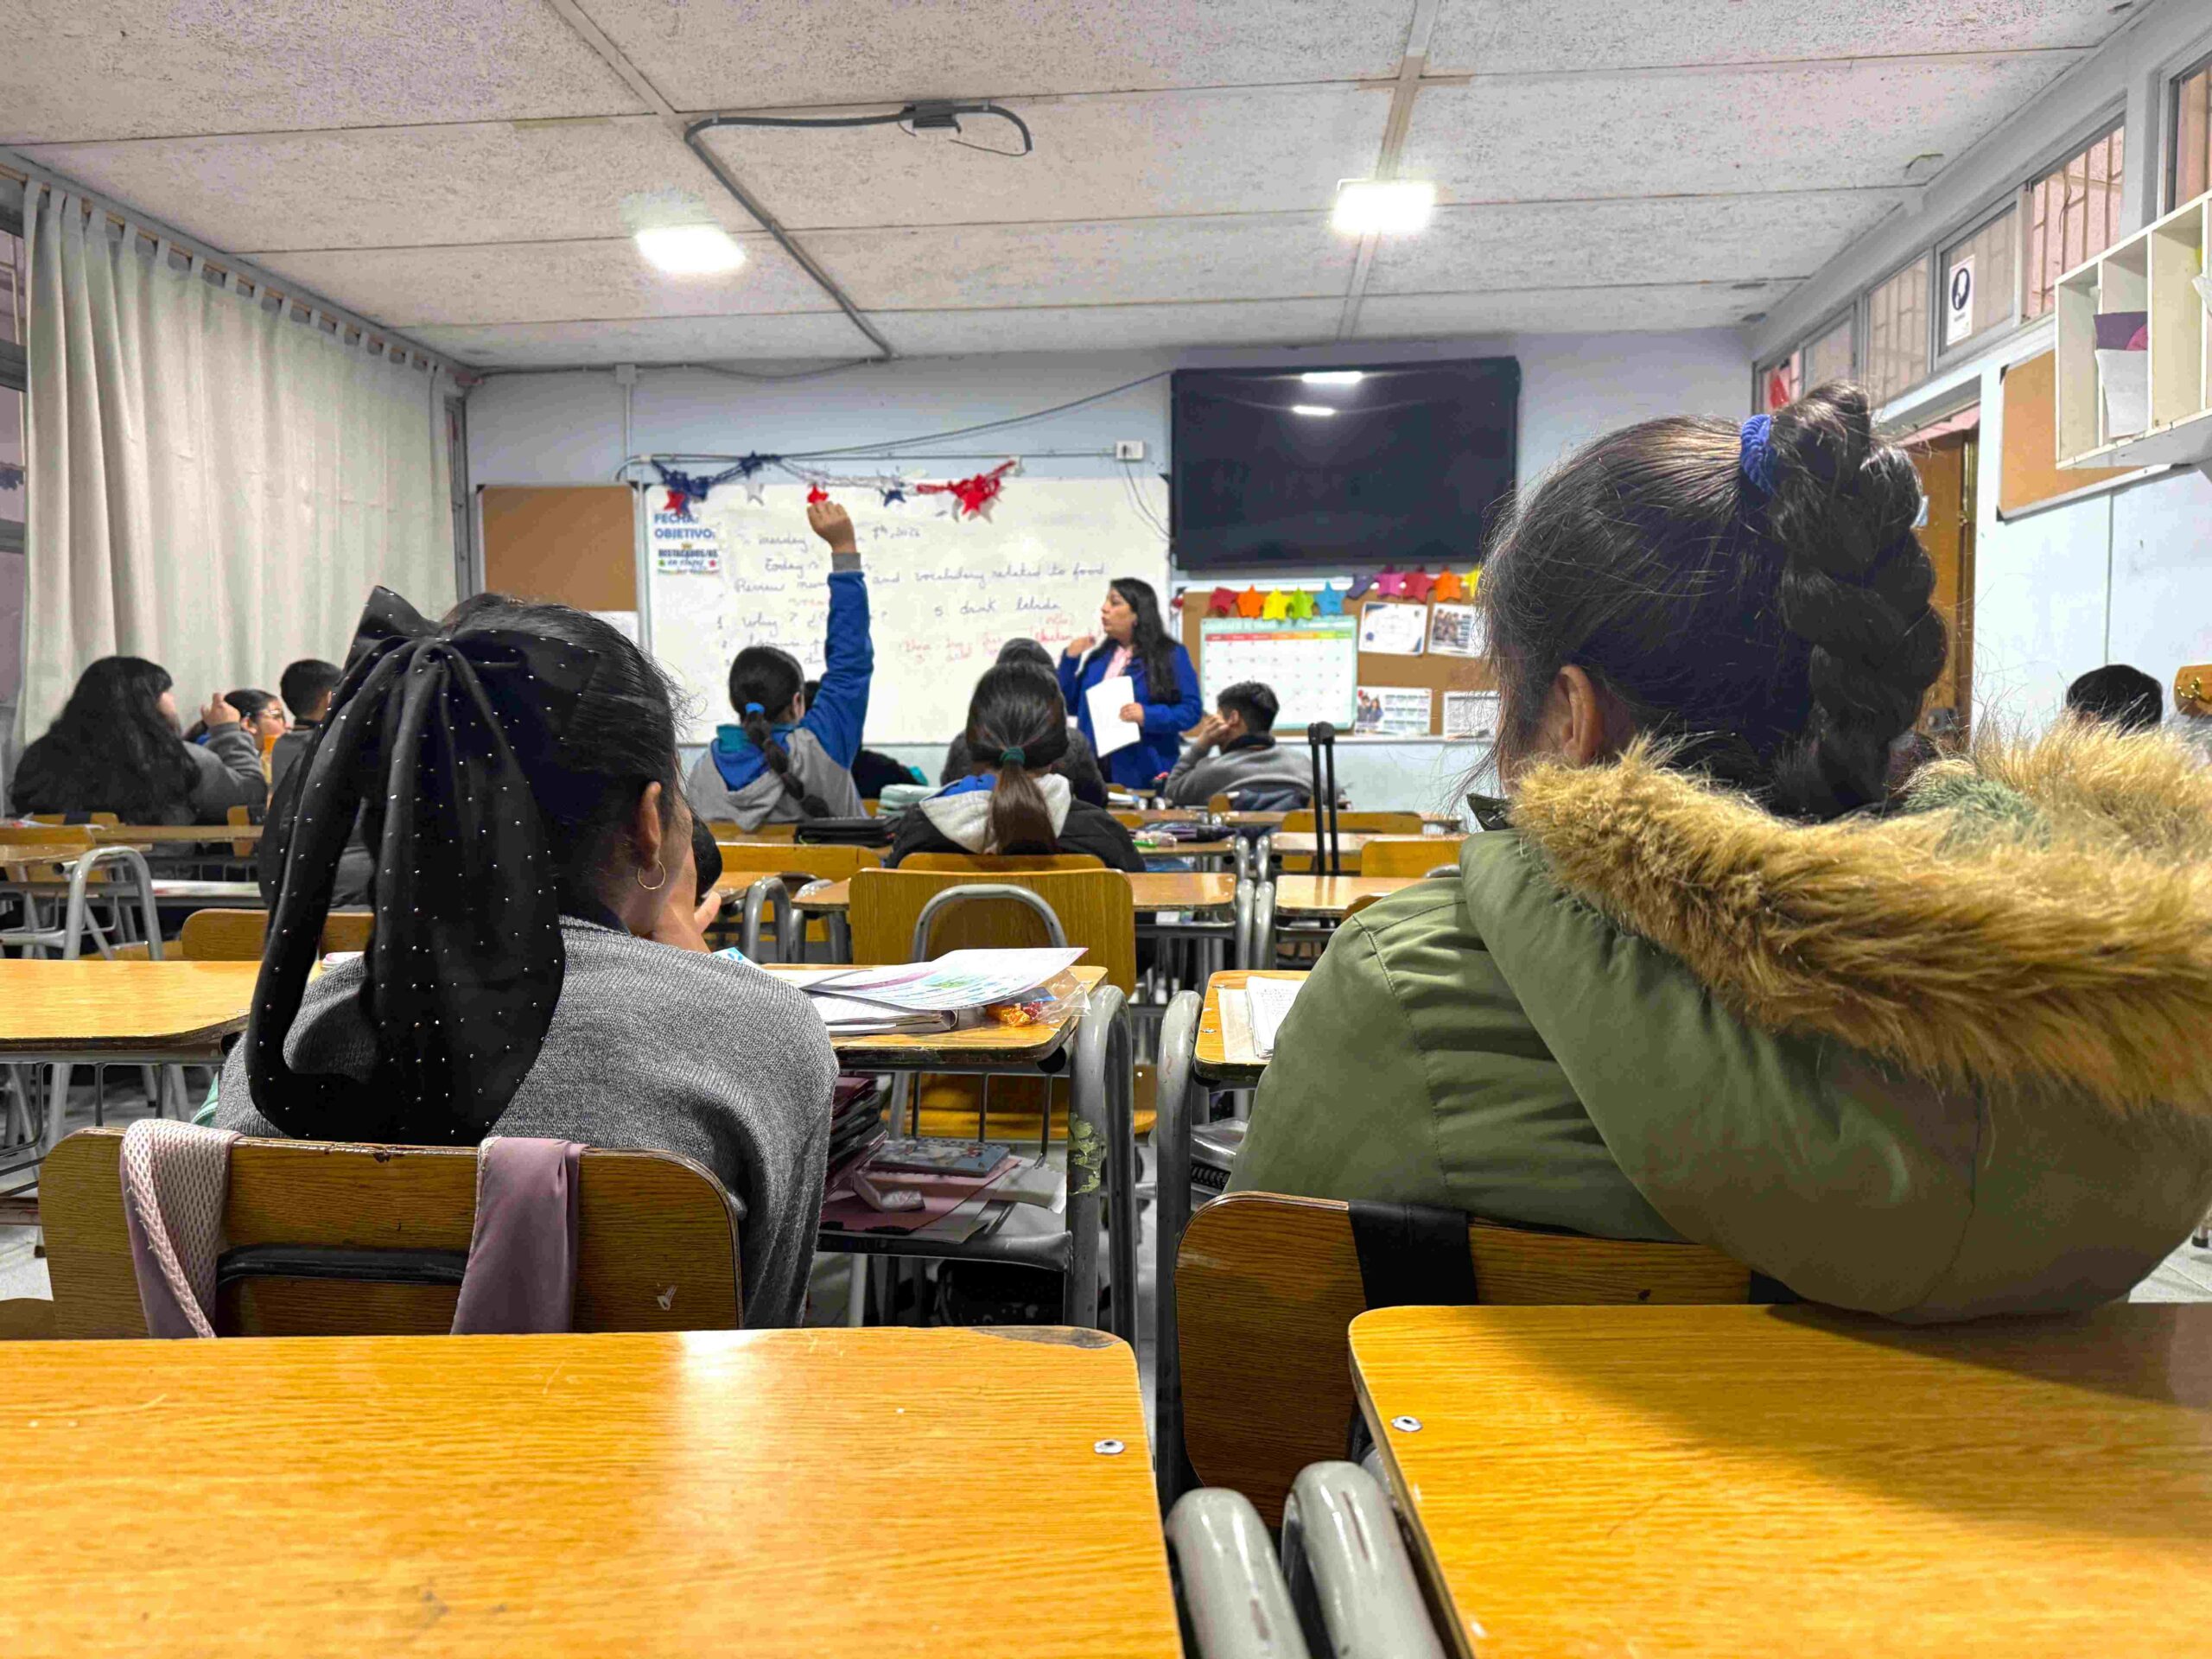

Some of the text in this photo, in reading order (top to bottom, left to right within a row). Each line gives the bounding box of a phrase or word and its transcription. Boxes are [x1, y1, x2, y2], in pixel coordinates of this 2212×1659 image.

[872, 572, 900, 585] and
[1048, 562, 1066, 575] to
[1072, 562, 1105, 581] food
